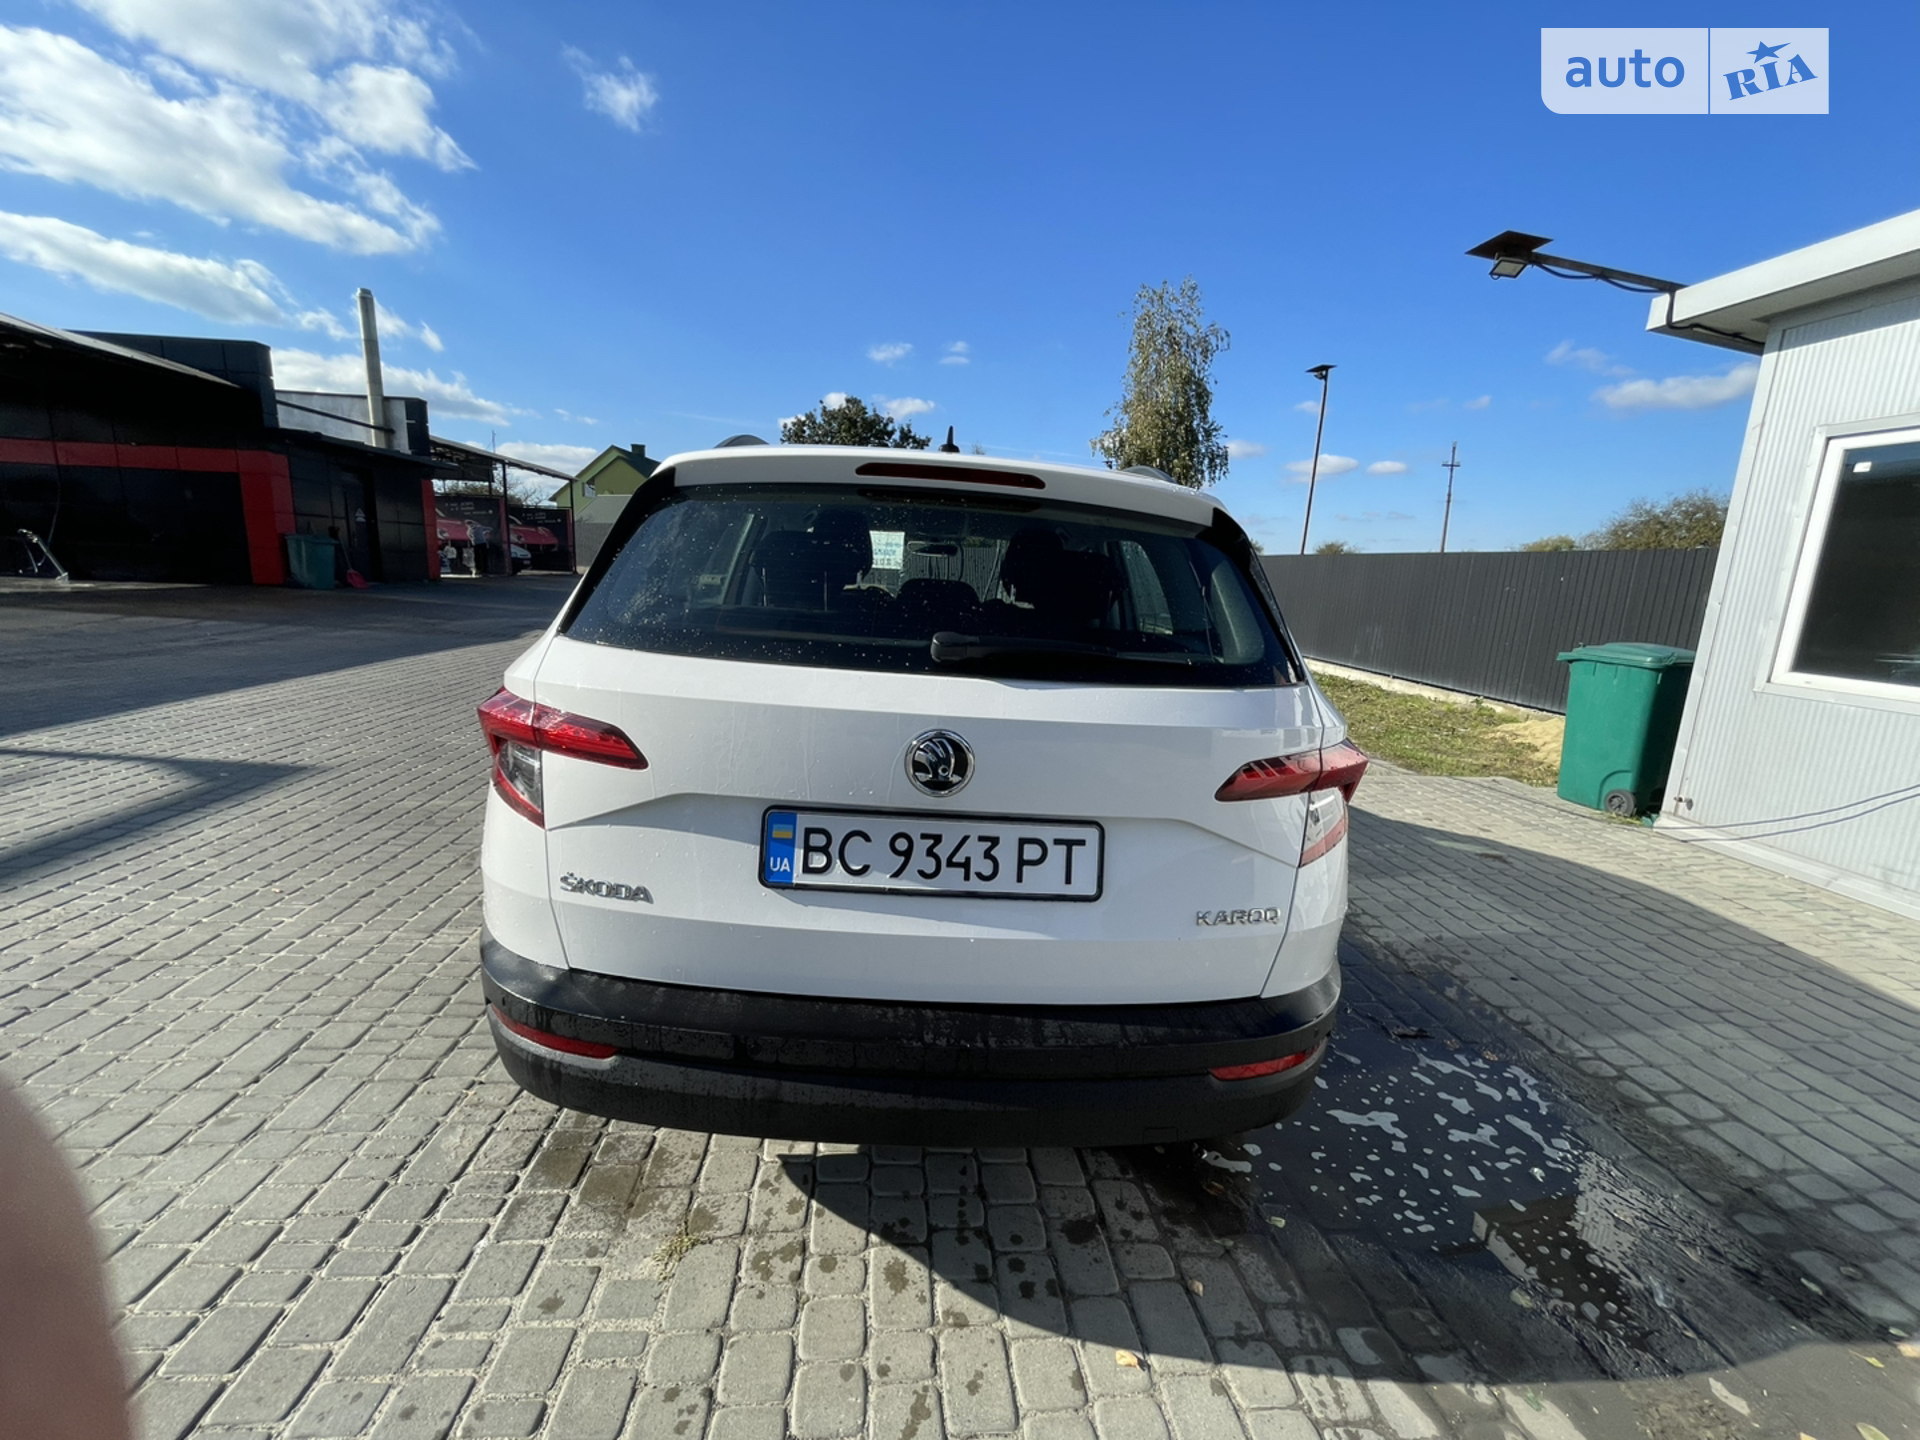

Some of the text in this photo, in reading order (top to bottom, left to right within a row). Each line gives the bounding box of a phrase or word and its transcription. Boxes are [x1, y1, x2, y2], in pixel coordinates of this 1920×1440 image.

[770, 857, 791, 873] UA
[802, 827, 1086, 886] BC 9343 PT
[1196, 907, 1281, 926] KAROQ
